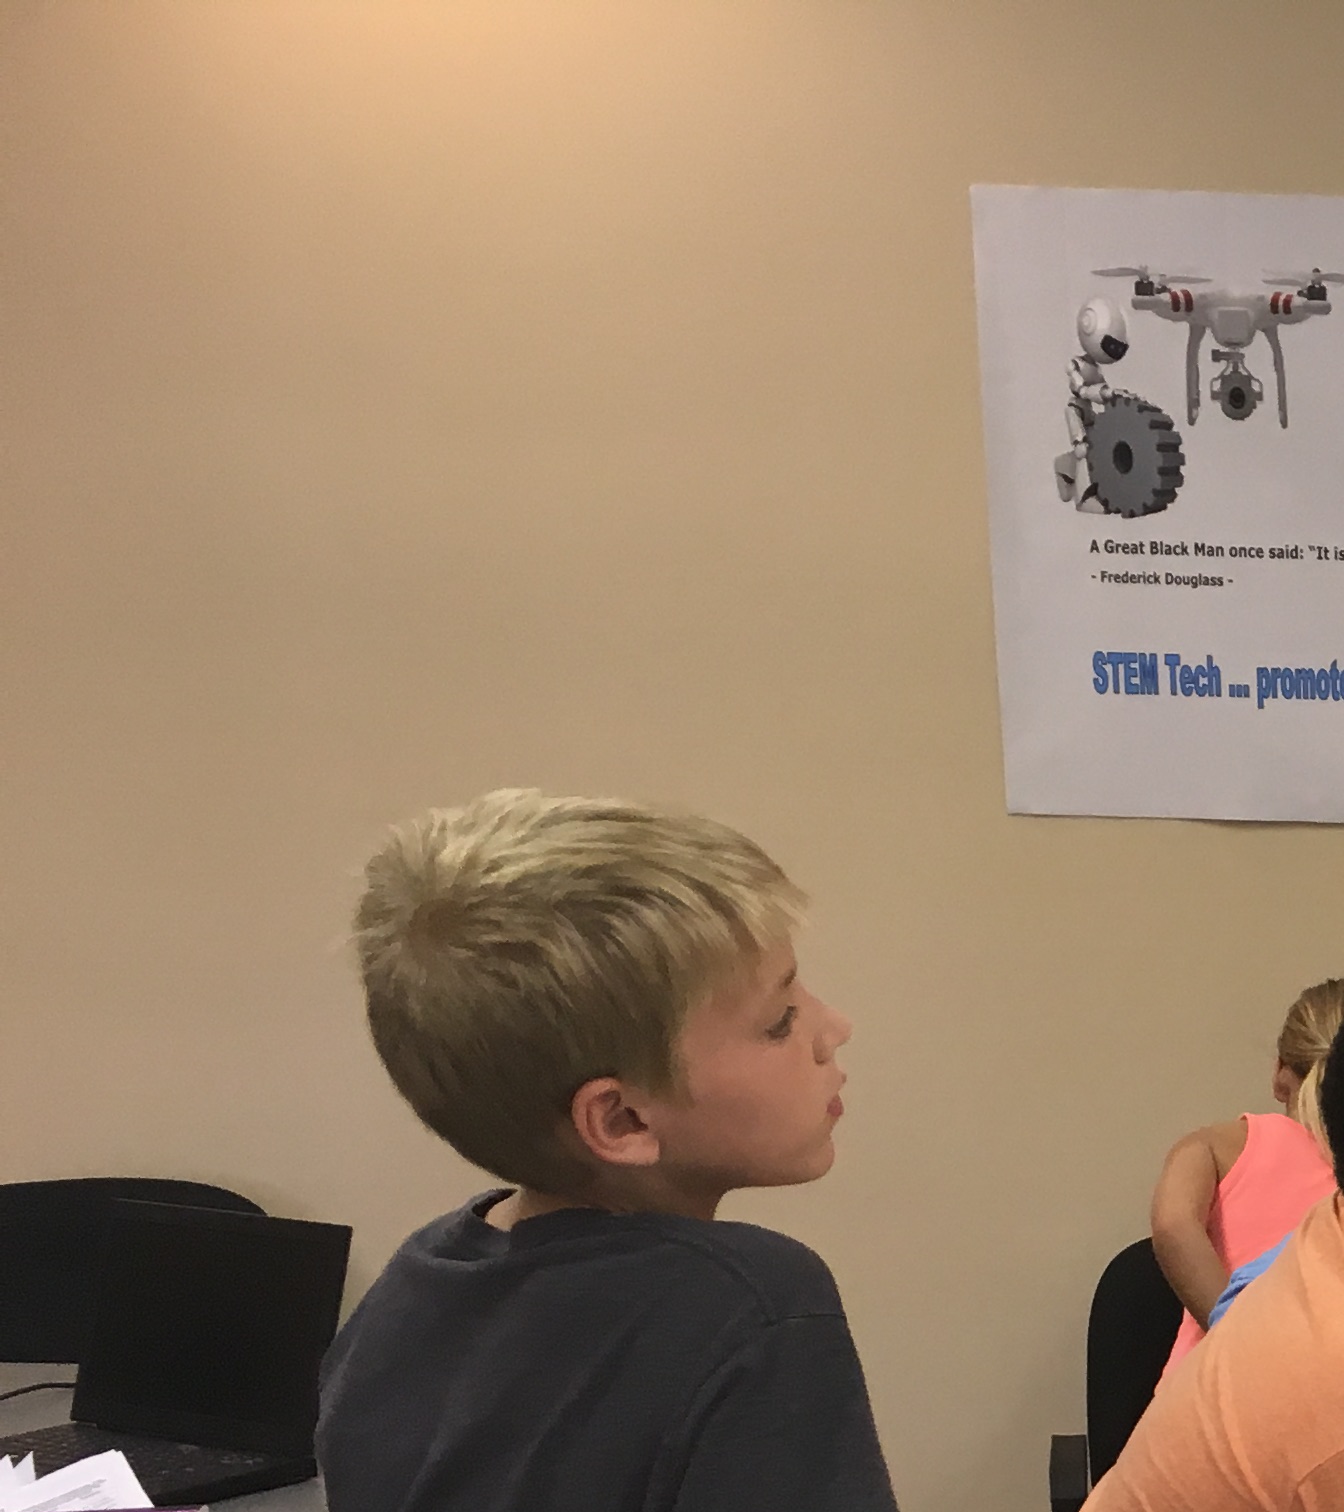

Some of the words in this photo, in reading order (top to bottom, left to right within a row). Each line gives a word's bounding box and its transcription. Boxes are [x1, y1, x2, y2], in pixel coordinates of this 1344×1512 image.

[1090, 539, 1100, 554] A
[1104, 540, 1145, 556] Great
[1150, 541, 1189, 556] Black
[1194, 542, 1225, 557] Man
[1229, 545, 1264, 559] once
[1269, 544, 1304, 560] said:
[1100, 570, 1161, 585] Frederick
[1165, 572, 1224, 589] Douglass
[1092, 651, 1159, 695] STEM
[1165, 653, 1221, 697] Tech
